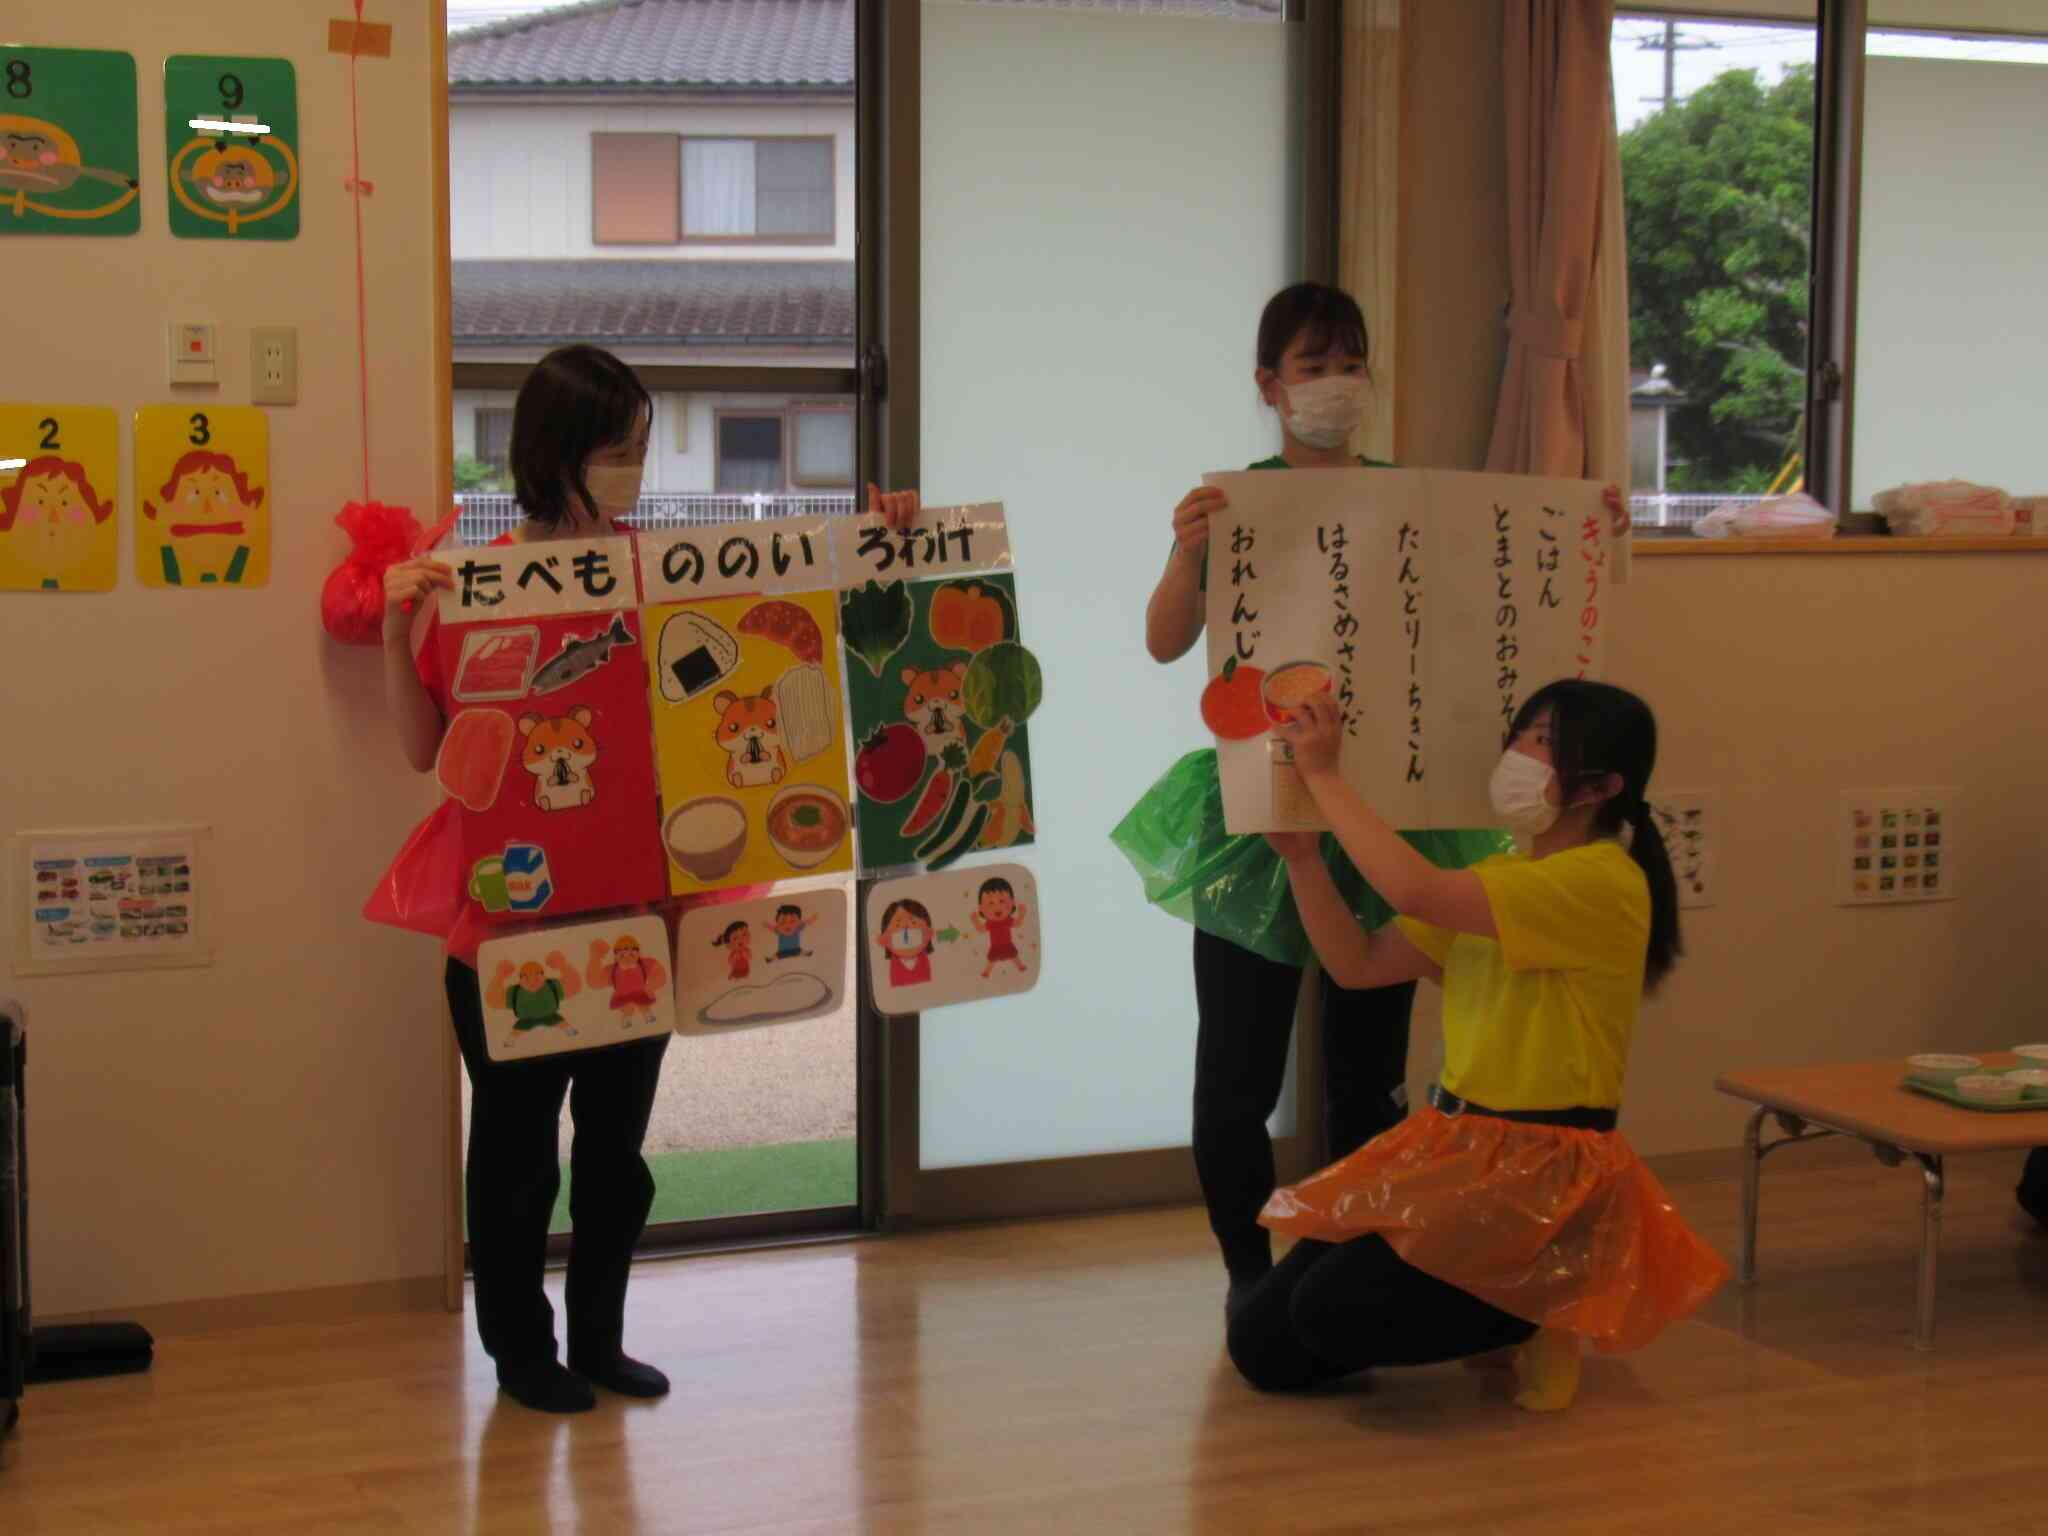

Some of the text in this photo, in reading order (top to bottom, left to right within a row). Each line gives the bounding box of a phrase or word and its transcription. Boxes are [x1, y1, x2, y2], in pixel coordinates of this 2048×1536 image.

[5, 59, 34, 99] 8
[218, 73, 244, 110] 9
[38, 417, 61, 451] 2
[188, 413, 211, 446] 3
[1537, 506, 1565, 609] ごはん
[1231, 526, 1261, 661] おれんじ
[1577, 514, 1605, 681] きょうのこ
[1397, 522, 1425, 784] たんどりーちきん
